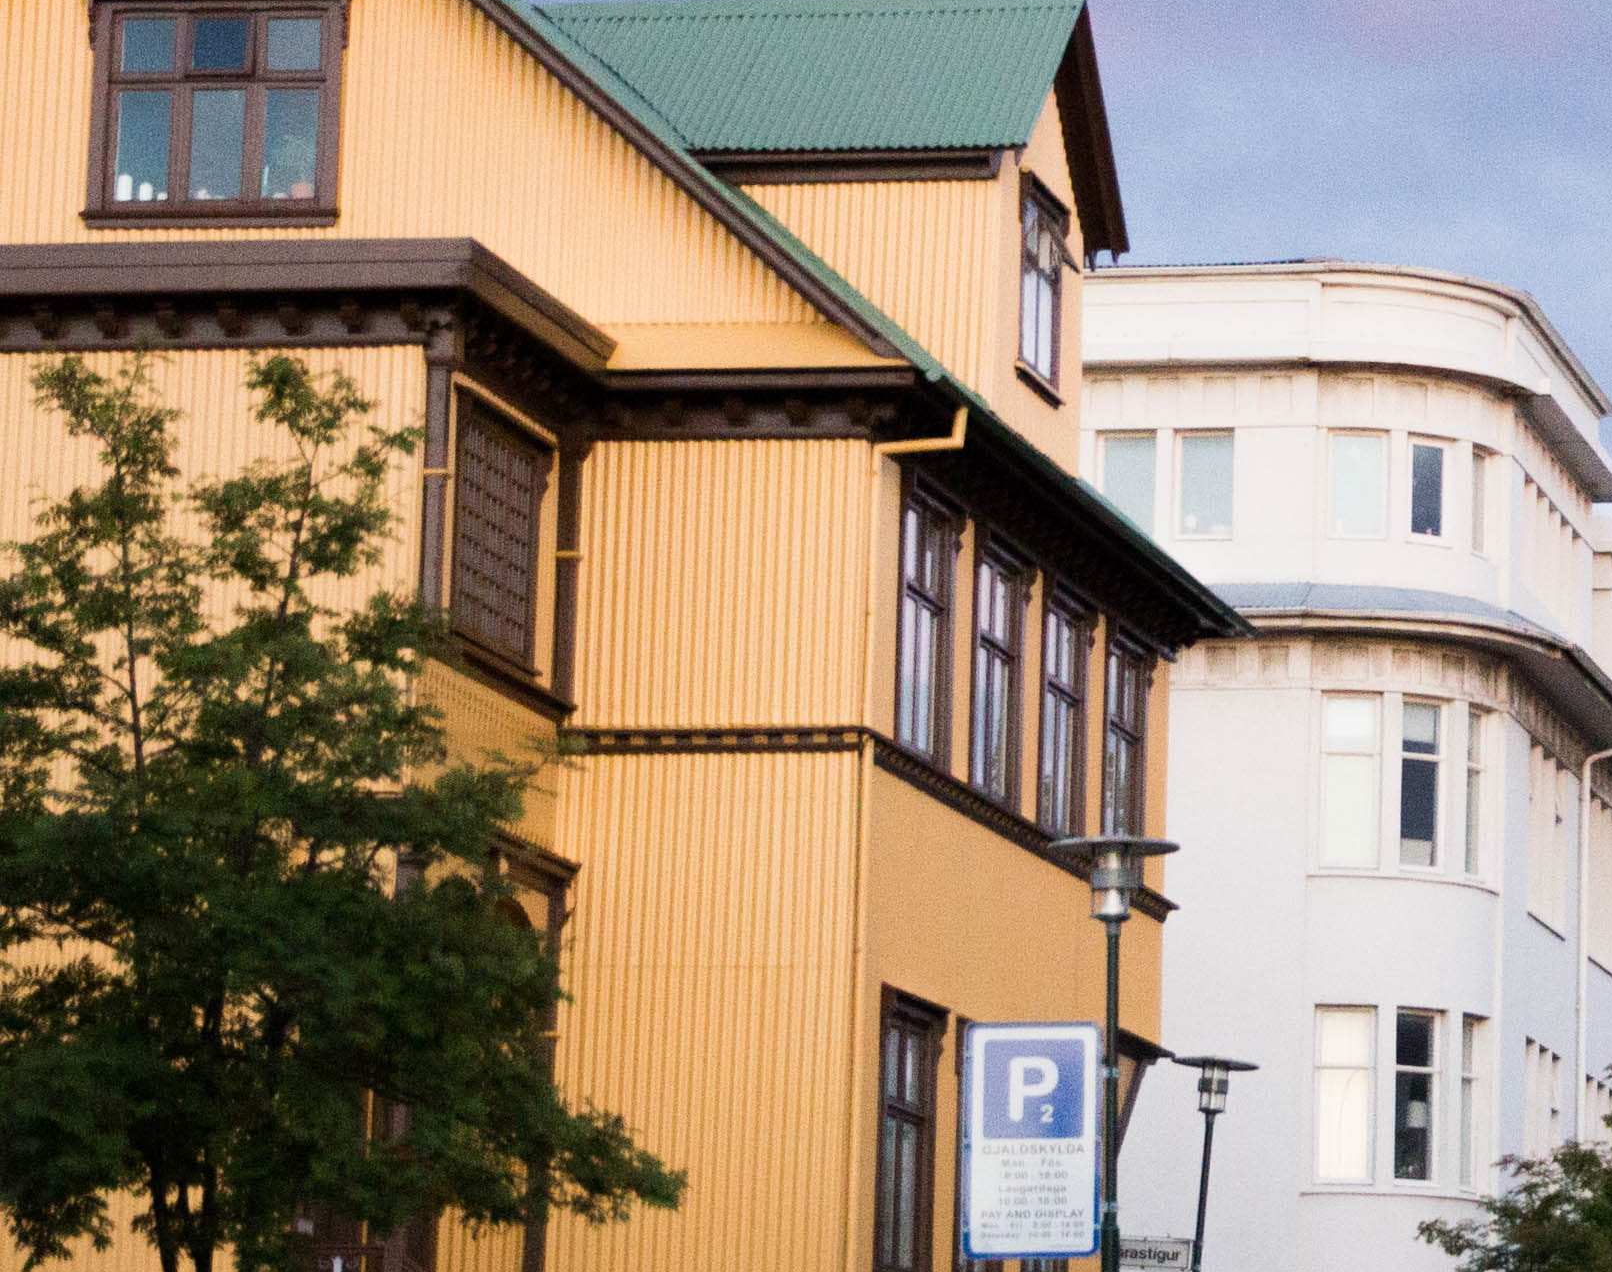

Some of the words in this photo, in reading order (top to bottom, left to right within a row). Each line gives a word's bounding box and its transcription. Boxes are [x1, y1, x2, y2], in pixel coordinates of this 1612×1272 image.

[1009, 1056, 1060, 1122] P
[1040, 1105, 1054, 1123] 2
[982, 1143, 1085, 1155] GJALDSKYLDA
[981, 1210, 1002, 1219] PAY
[1006, 1209, 1032, 1219] AND
[1034, 1209, 1085, 1219] DISPLAY
